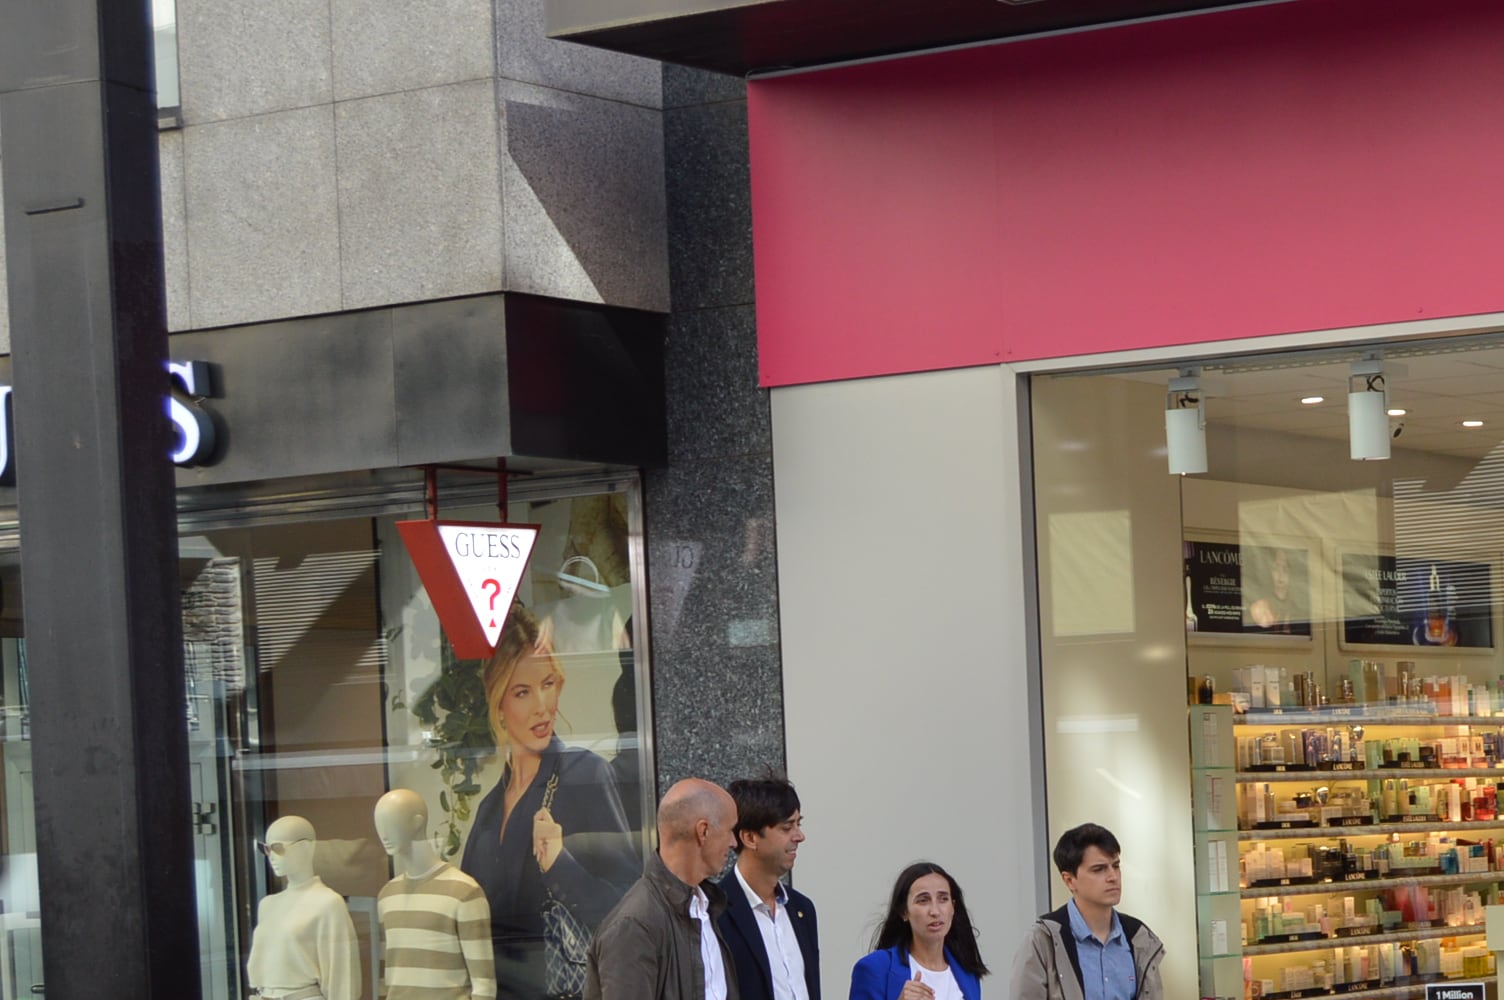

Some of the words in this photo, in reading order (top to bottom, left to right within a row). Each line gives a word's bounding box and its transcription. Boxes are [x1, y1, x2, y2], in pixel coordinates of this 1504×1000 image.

[455, 532, 521, 559] GUESS
[1436, 991, 1441, 1000] 1
[1442, 990, 1474, 999] Million
